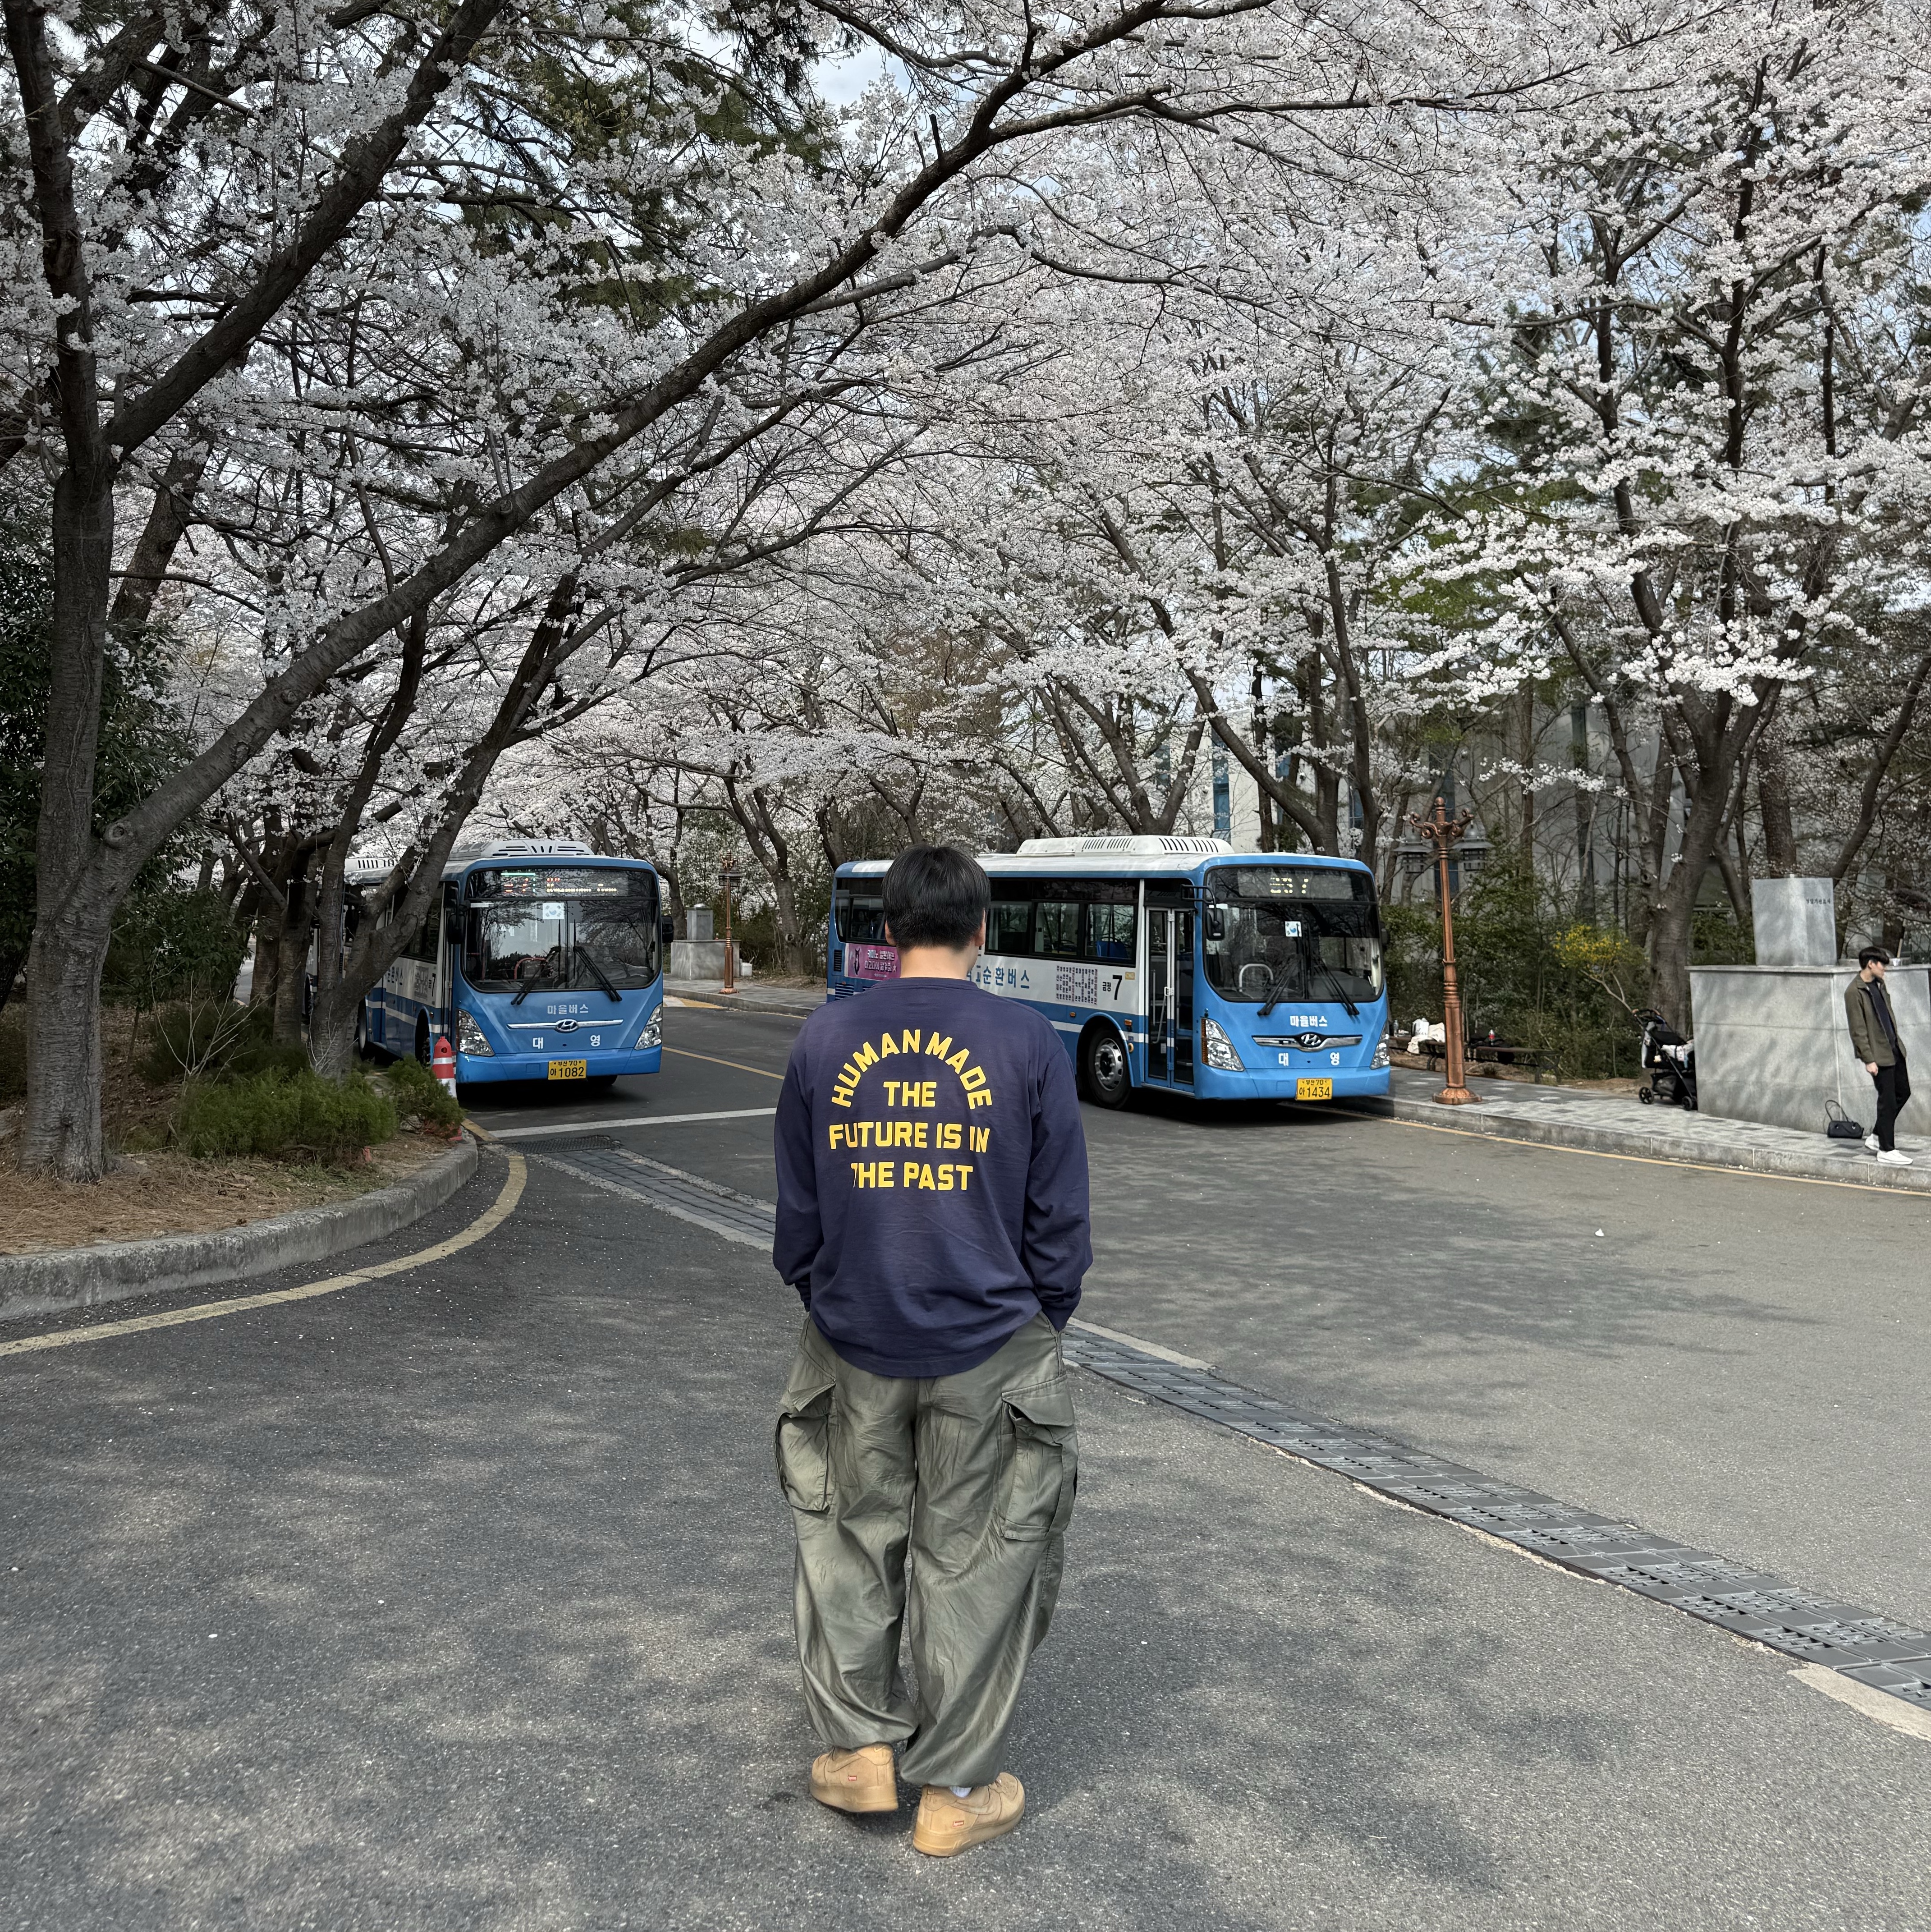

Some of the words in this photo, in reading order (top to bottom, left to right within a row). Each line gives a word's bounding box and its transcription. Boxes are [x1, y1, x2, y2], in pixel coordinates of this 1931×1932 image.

[1112, 974, 1123, 1000] 7
[547, 1004, 589, 1014] 마을버스
[1290, 1015, 1328, 1027] 마을버스
[532, 1037, 544, 1049] 대
[590, 1034, 601, 1047] 영
[1278, 1052, 1289, 1066] 대
[1330, 1052, 1339, 1065] 영
[883, 1081, 937, 1107] THE
[829, 1121, 928, 1149] FUTURE
[936, 1123, 962, 1149] IS
[969, 1126, 990, 1153] IN
[903, 1161, 973, 1190] PAST
